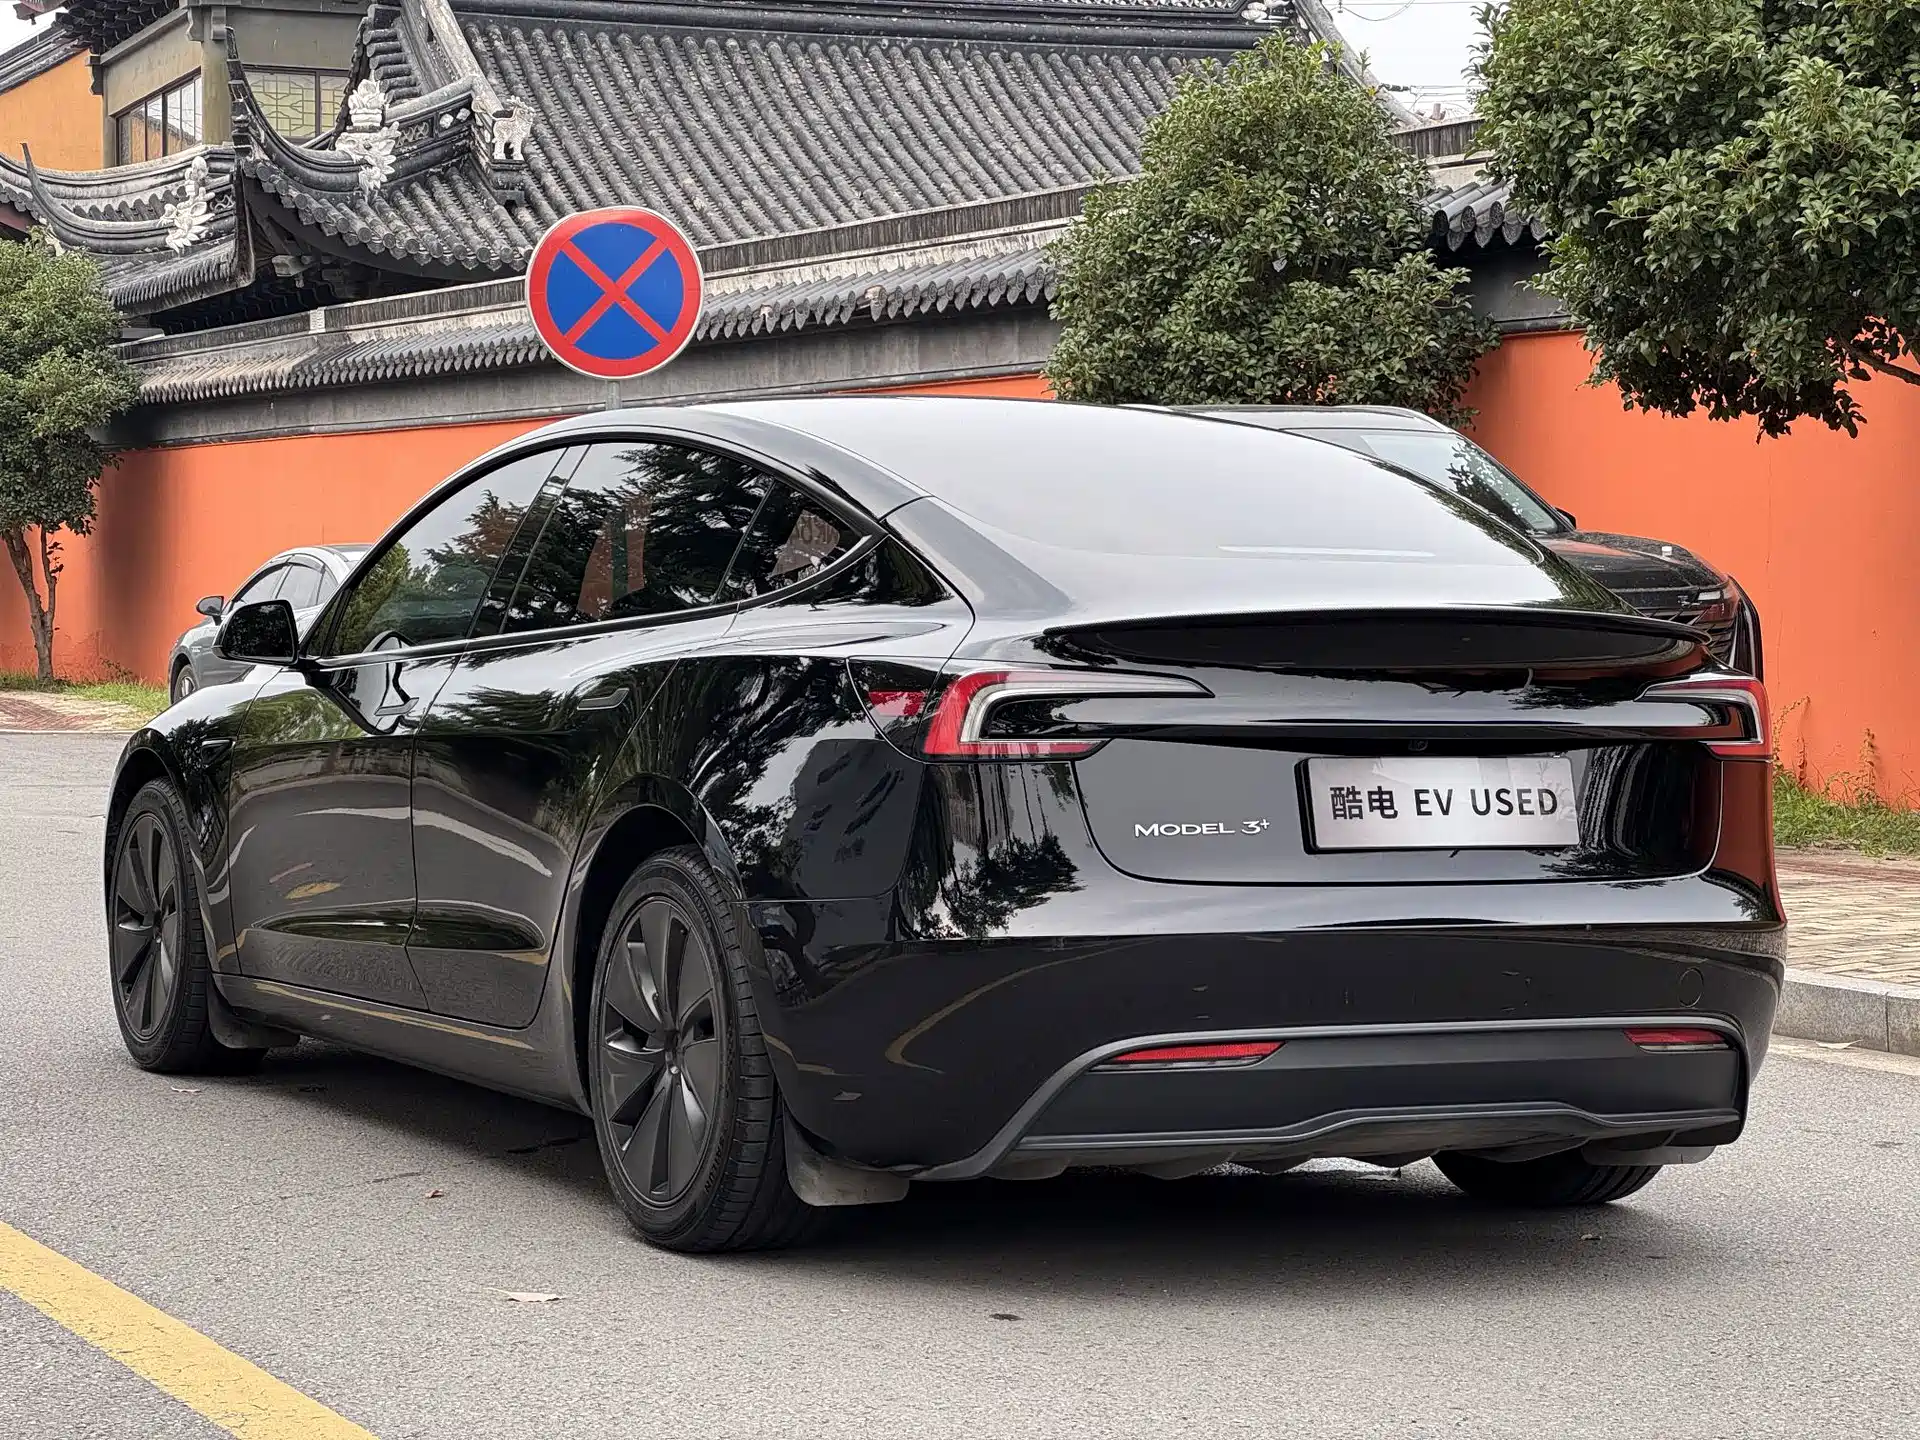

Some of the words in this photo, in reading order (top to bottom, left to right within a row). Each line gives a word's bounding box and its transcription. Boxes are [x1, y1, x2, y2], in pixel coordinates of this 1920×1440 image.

[1329, 785, 1398, 820] 酷电
[1414, 788, 1453, 816] EV
[1471, 788, 1558, 816] USED
[1134, 822, 1235, 837] MODEL
